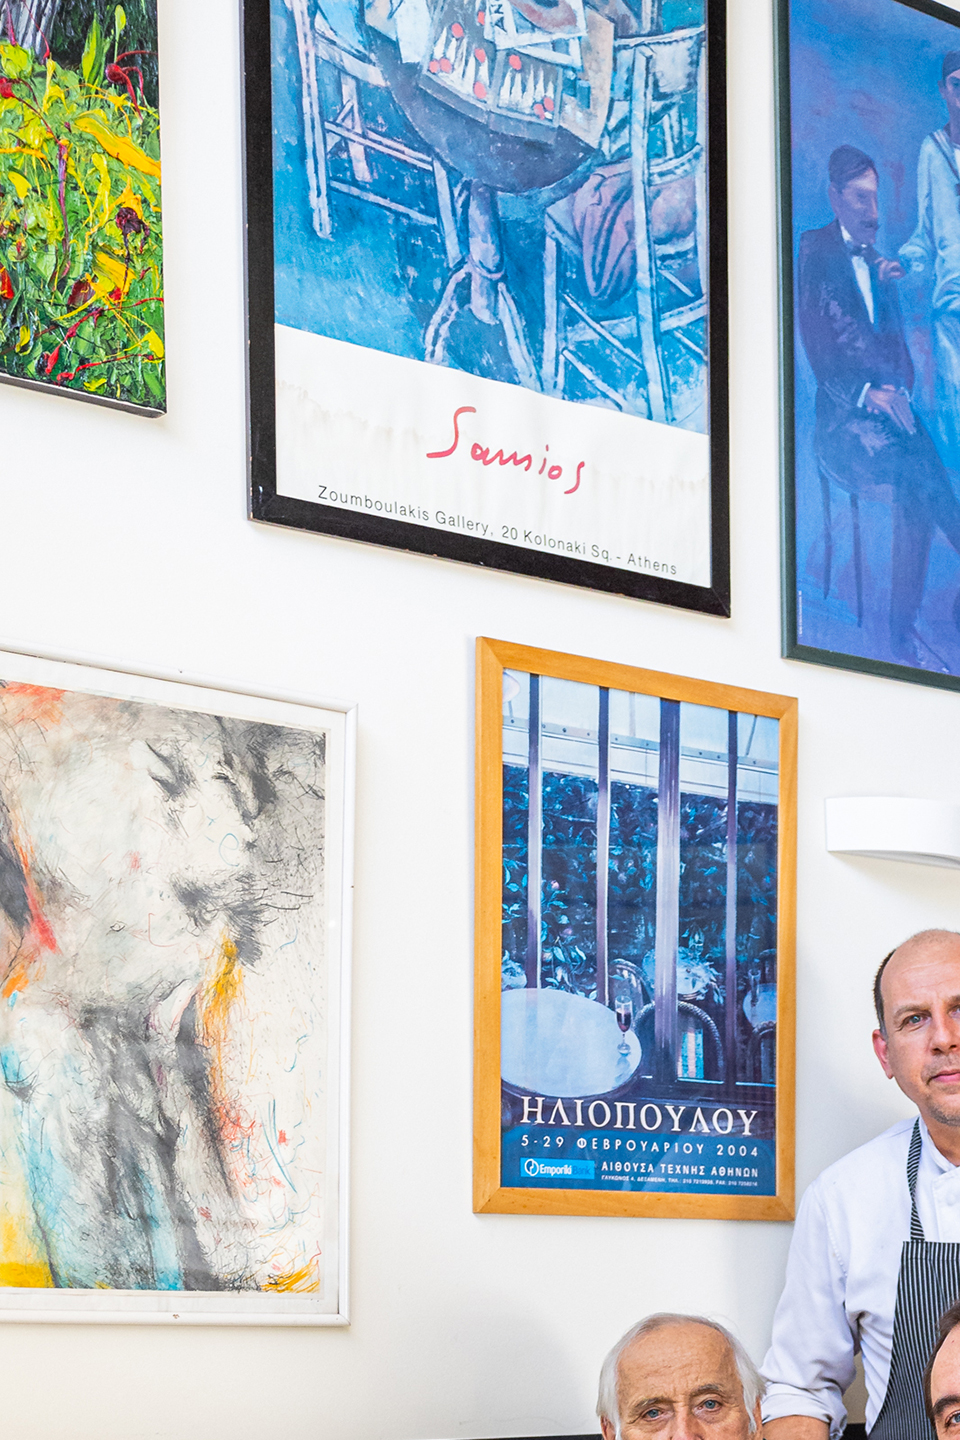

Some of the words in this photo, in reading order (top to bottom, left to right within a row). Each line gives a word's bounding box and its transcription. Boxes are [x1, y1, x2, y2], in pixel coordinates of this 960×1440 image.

[426, 406, 586, 494] Samios
[317, 485, 430, 522] Zoumboulakis
[435, 510, 494, 536] Gallery,
[501, 525, 519, 541] 20
[523, 529, 587, 556] Kolonaki
[591, 544, 612, 563] Sq.
[627, 552, 678, 576] Athens
[520, 1096, 758, 1136] ΗΛΙΟΠΟΥΛΟΥ
[576, 1137, 704, 1155] ΦΕΒΡΟΥΑΡΙΟΥ
[716, 1144, 758, 1157] 2004
[540, 1163, 572, 1176] Emporiki
[572, 1165, 591, 1176] Bank
[601, 1161, 654, 1173] ΑΙΘΟΥΣΑ
[660, 1163, 705, 1176] ΤΕΧΝΗΣ
[711, 1166, 758, 1178] ΑΘΗΝΩΝ
